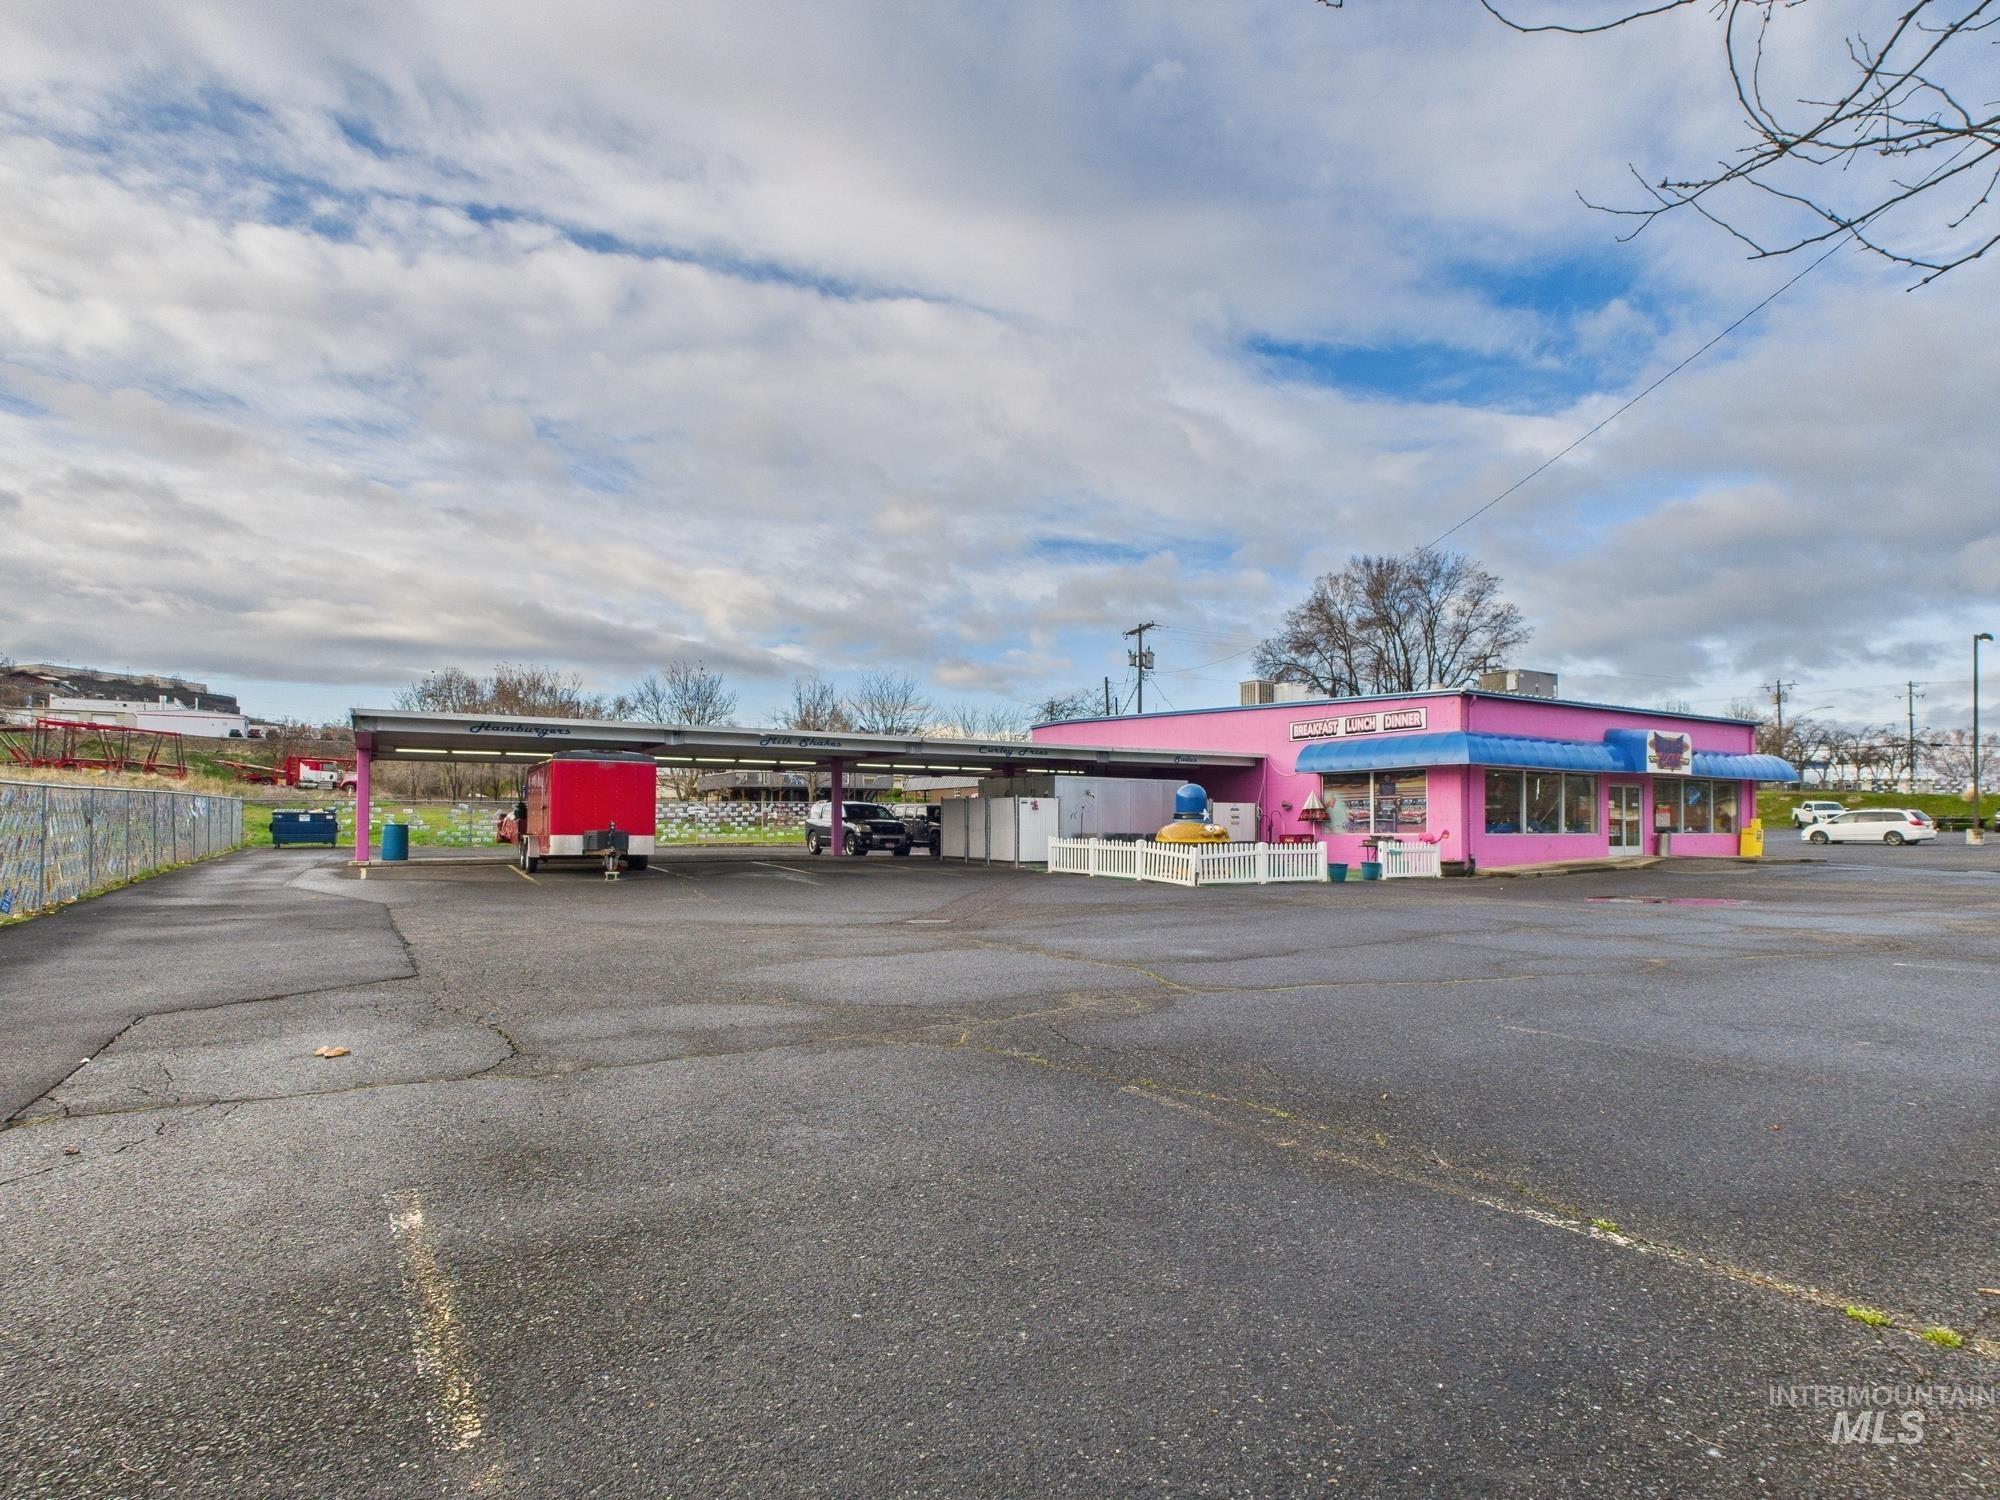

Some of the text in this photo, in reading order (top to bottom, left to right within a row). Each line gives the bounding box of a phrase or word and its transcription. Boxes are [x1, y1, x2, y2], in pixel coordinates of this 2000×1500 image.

[470, 722, 571, 737] Hamburgers
[1293, 710, 1422, 739] BREAKFAST LUNCH DINNER
[760, 735, 842, 748] Milk Shakes
